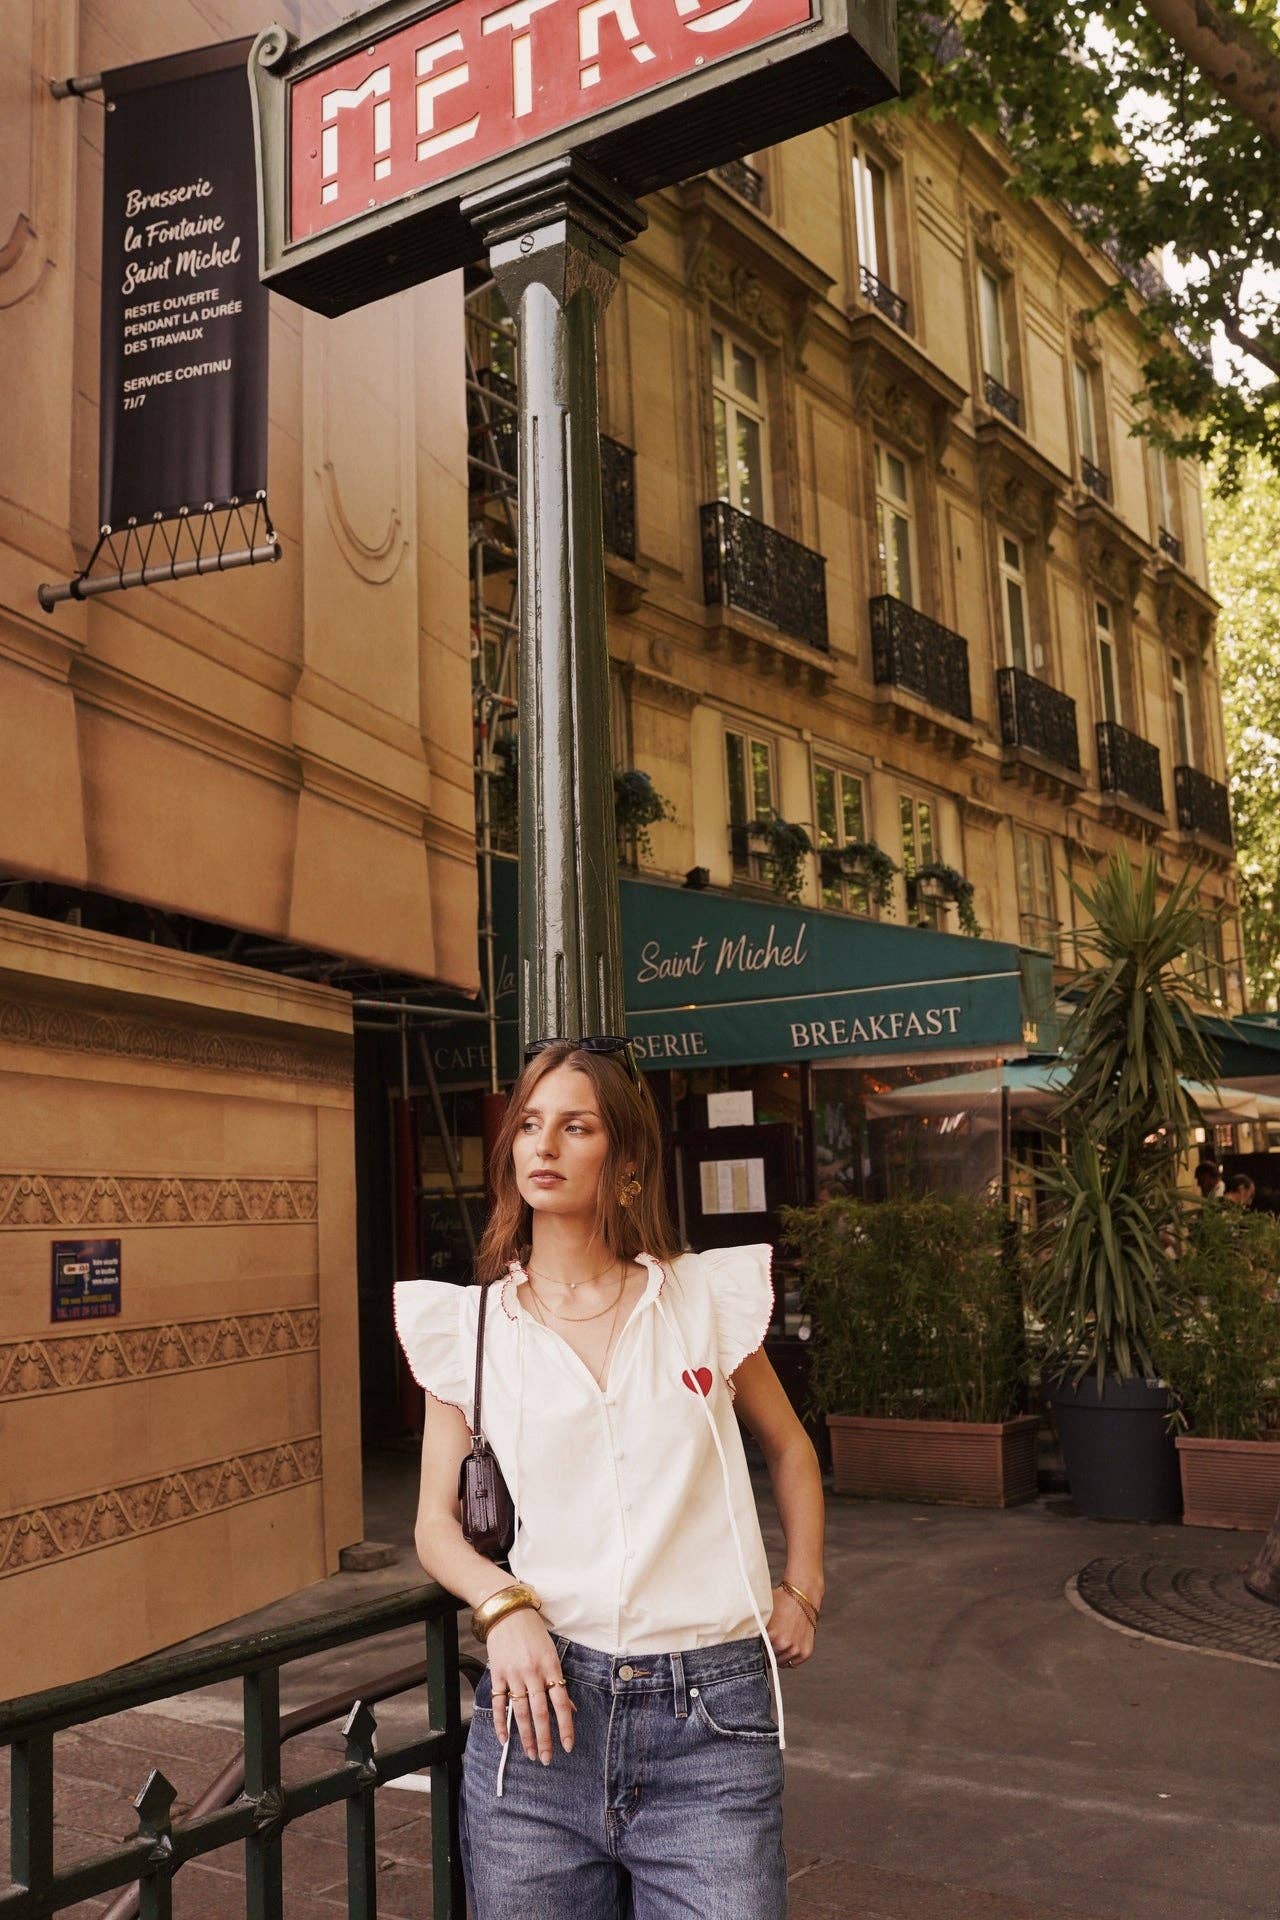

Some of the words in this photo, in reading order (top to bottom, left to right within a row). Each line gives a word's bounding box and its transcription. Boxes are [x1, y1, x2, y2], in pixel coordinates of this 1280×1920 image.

[125, 177, 213, 218] Brasserie
[124, 226, 142, 252] la
[145, 214, 225, 247] Fontaine
[121, 256, 172, 295] Saint
[175, 236, 241, 278] Michel
[124, 302, 161, 320] RESTE
[163, 288, 220, 310] OUVERTE
[124, 314, 180, 337] PENDANT
[182, 311, 199, 324] LA
[201, 300, 243, 320] DURÉE
[124, 340, 148, 355] DES
[150, 327, 204, 348] TRAVAUX
[123, 371, 173, 392] SERVICE
[174, 358, 232, 381] CONTINU
[636, 936, 709, 983] Saint
[715, 923, 808, 975] Michel
[790, 1006, 961, 1048] BREAKFAST
